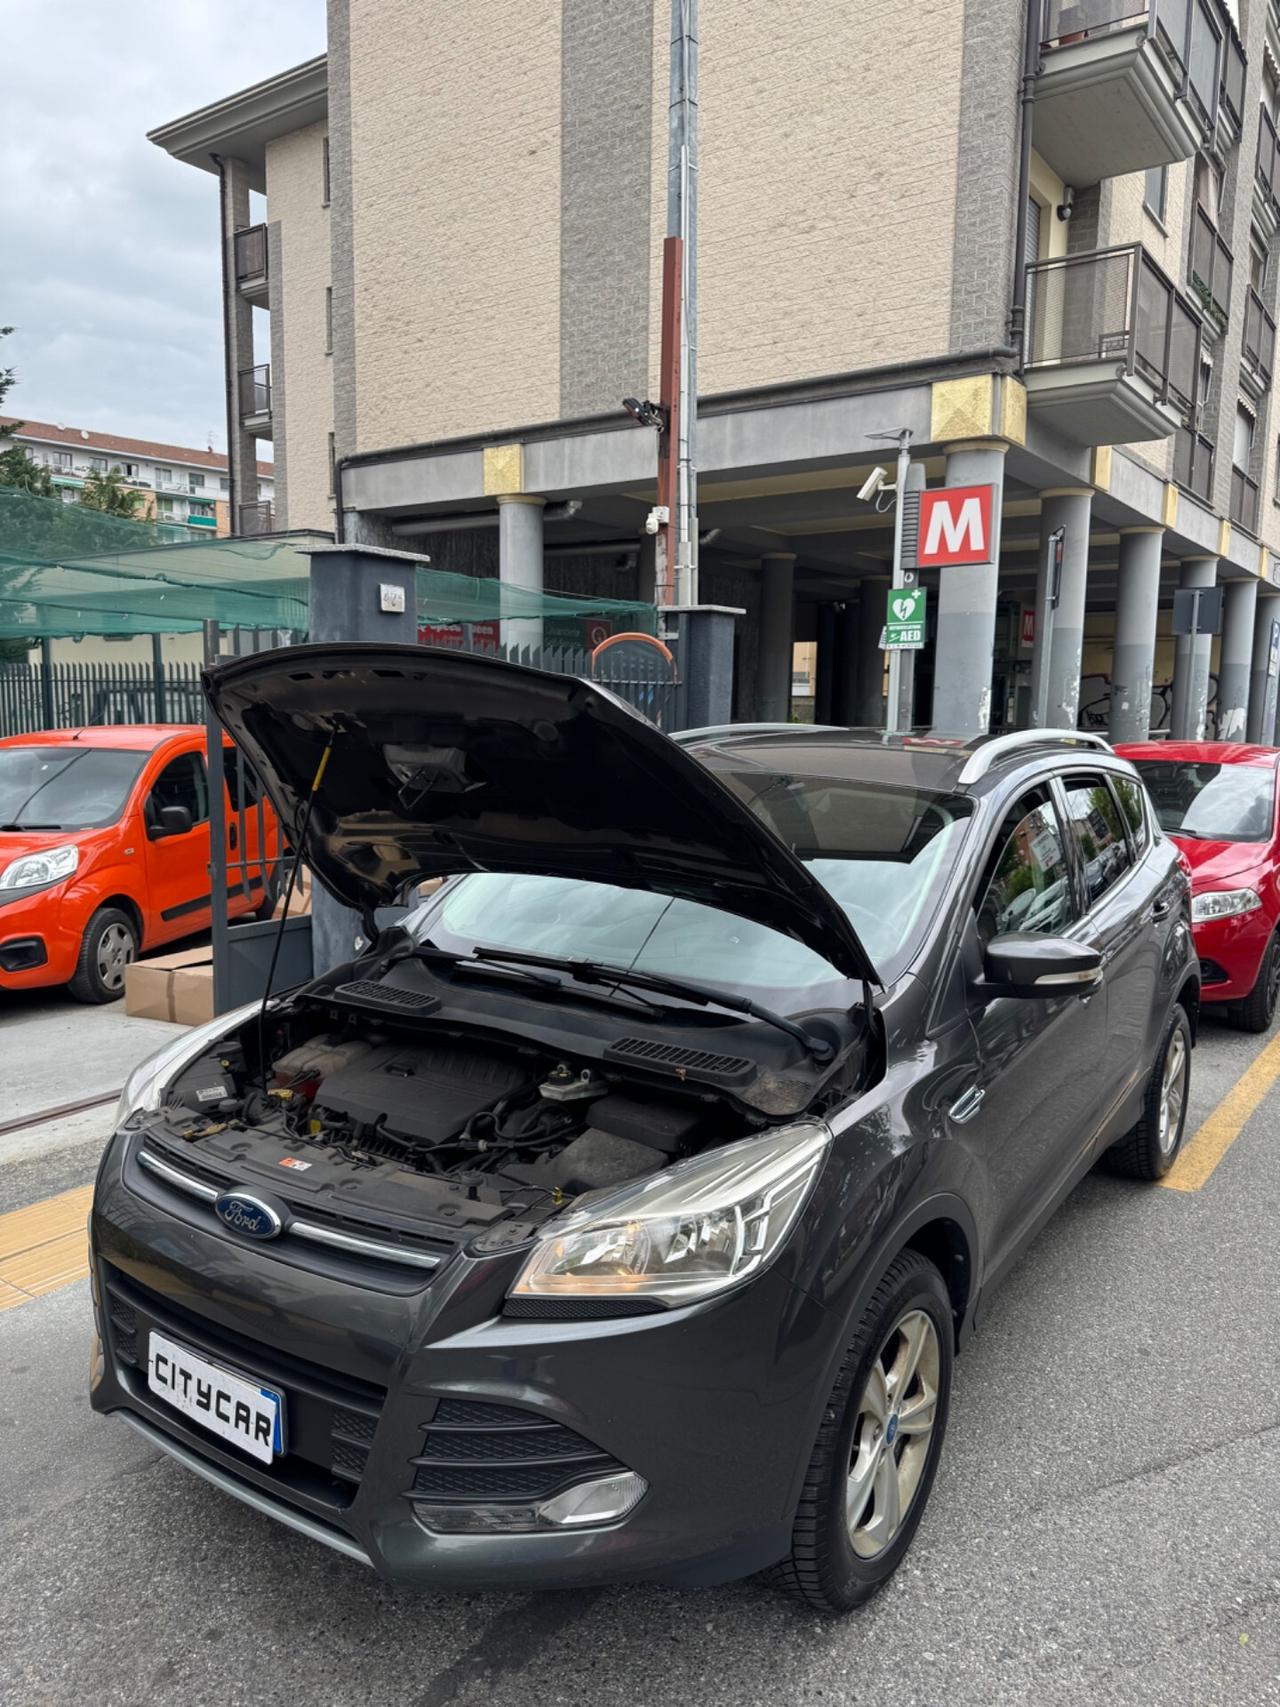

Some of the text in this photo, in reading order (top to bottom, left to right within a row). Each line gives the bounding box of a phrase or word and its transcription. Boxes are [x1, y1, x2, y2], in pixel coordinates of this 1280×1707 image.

[923, 497, 984, 555] M
[899, 630, 921, 642] AED
[224, 1200, 262, 1231] Ford
[154, 1352, 271, 1447] CITYCAR
